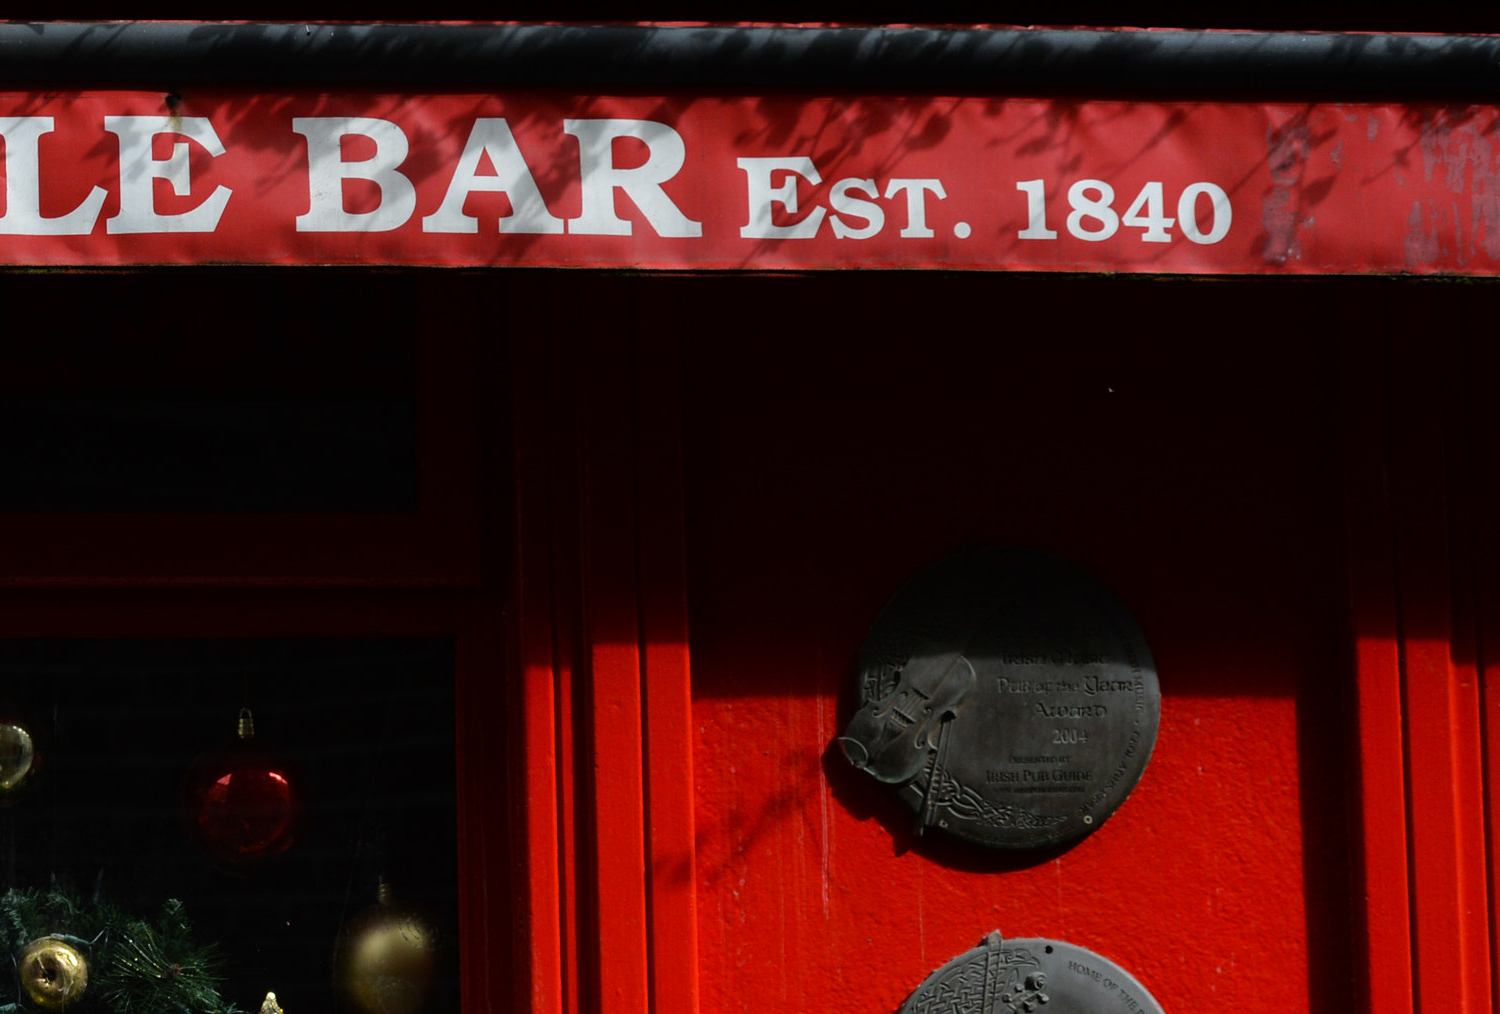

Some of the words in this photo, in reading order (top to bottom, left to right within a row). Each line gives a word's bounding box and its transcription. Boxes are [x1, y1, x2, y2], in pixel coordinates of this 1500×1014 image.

[292, 116, 703, 238] BAR
[1017, 178, 1233, 244] 1840
[1056, 680, 1080, 693] the
[1051, 728, 1088, 744] 2004
[1023, 769, 1050, 783] PUB
[1067, 960, 1103, 982] HOME
[1101, 977, 1118, 992] OF
[1116, 989, 1138, 1010] THE
